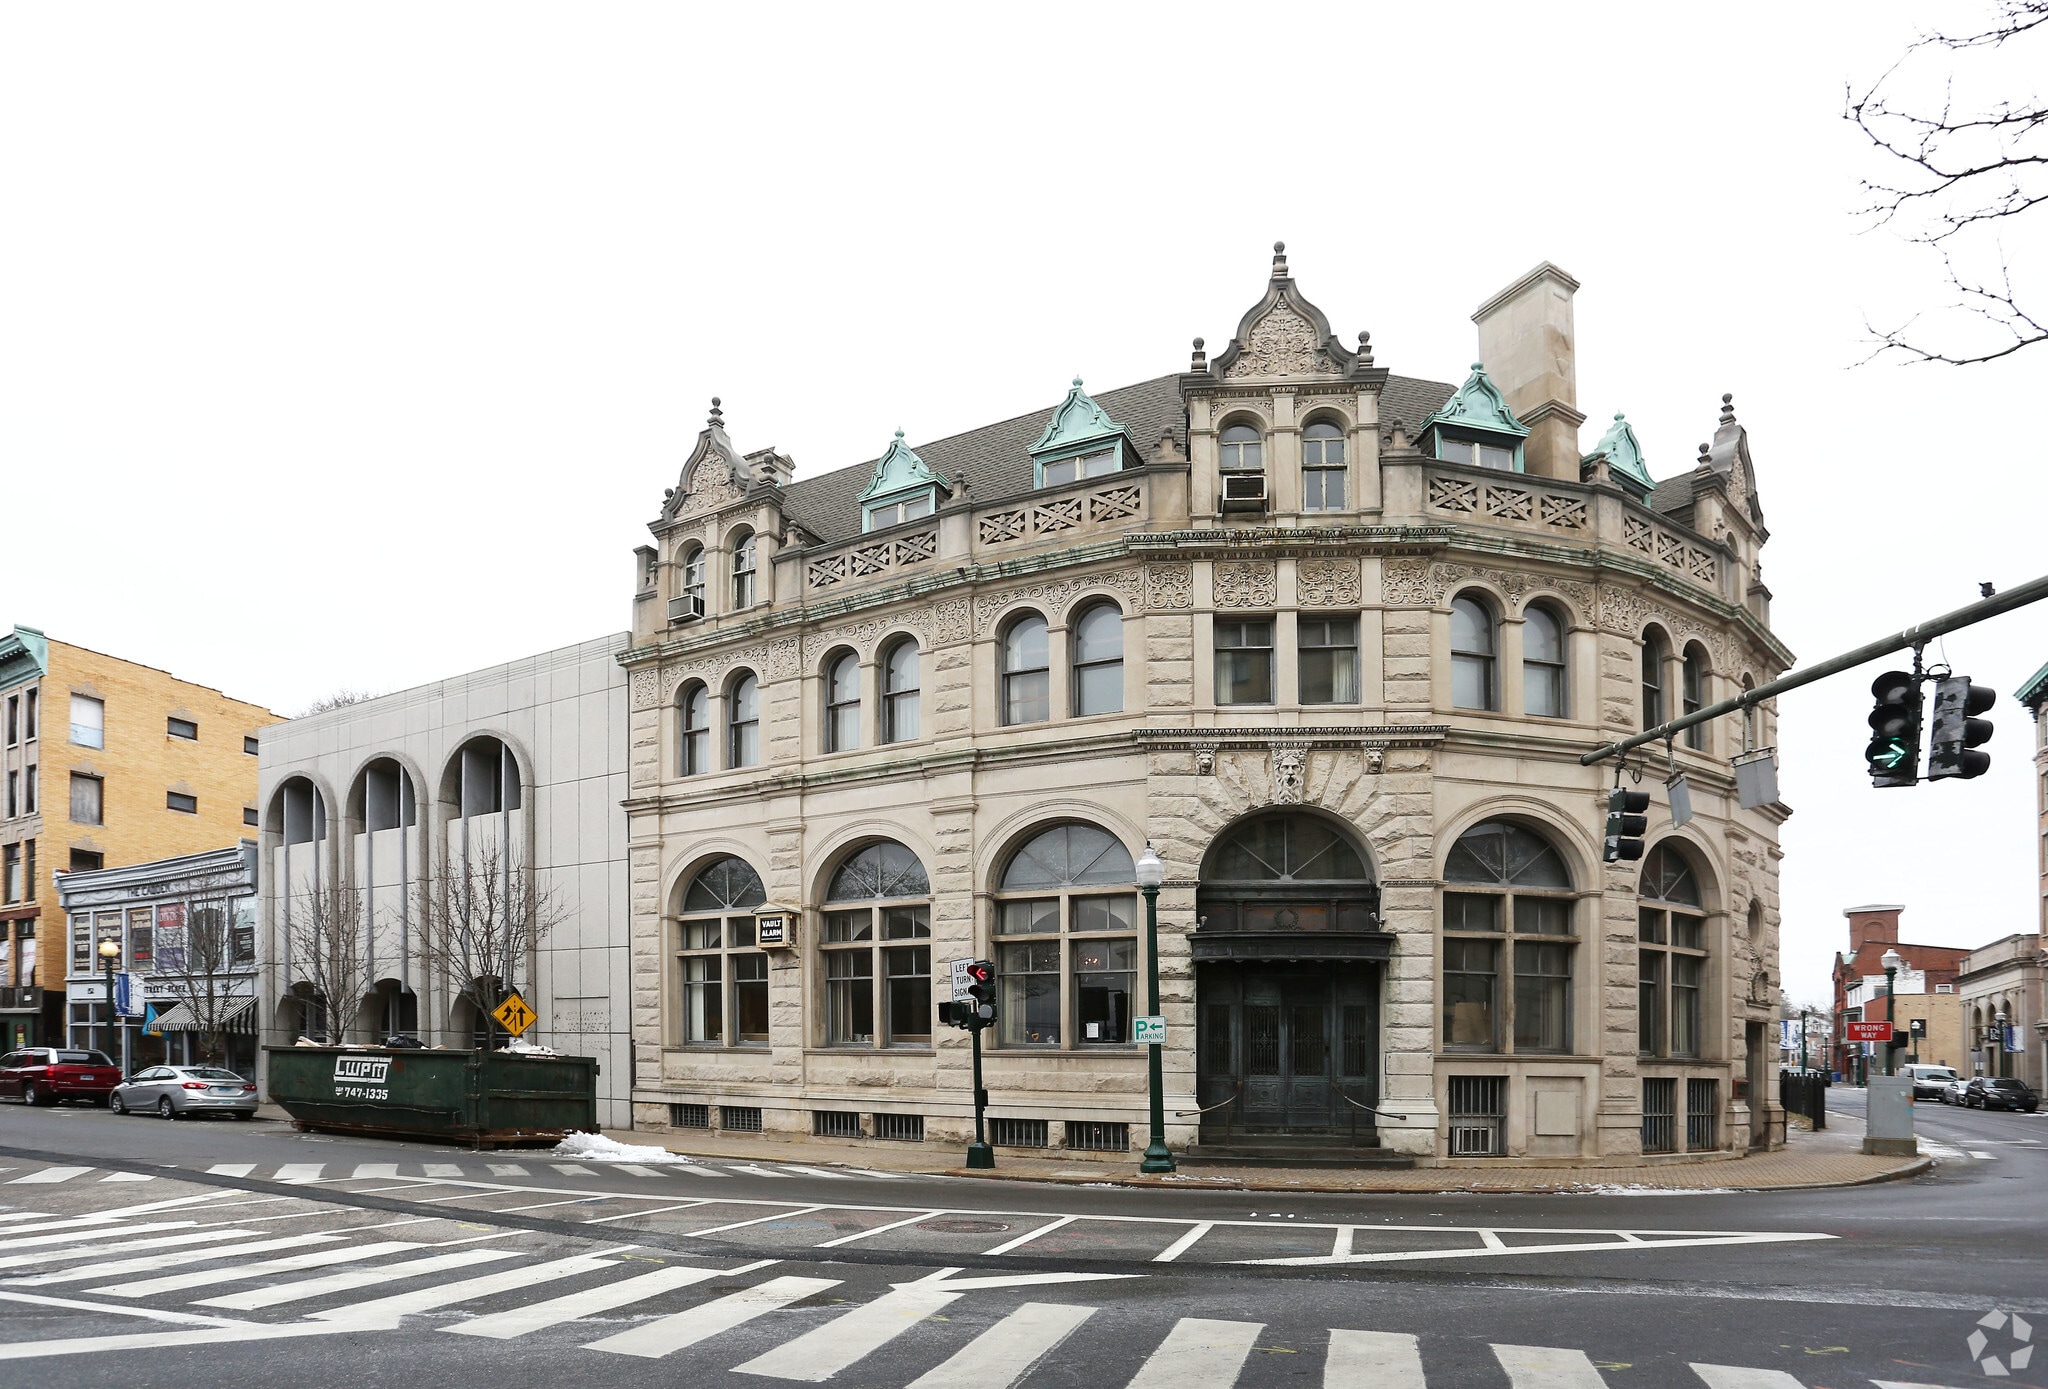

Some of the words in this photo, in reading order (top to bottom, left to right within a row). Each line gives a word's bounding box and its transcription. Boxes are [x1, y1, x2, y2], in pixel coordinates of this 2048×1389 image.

[761, 920, 781, 928] VAULT
[761, 929, 782, 937] ALARM
[956, 975, 971, 984] TURN
[954, 988, 969, 997] SIGN
[1135, 1020, 1164, 1040] PARKING
[344, 1086, 389, 1100] 747-1335
